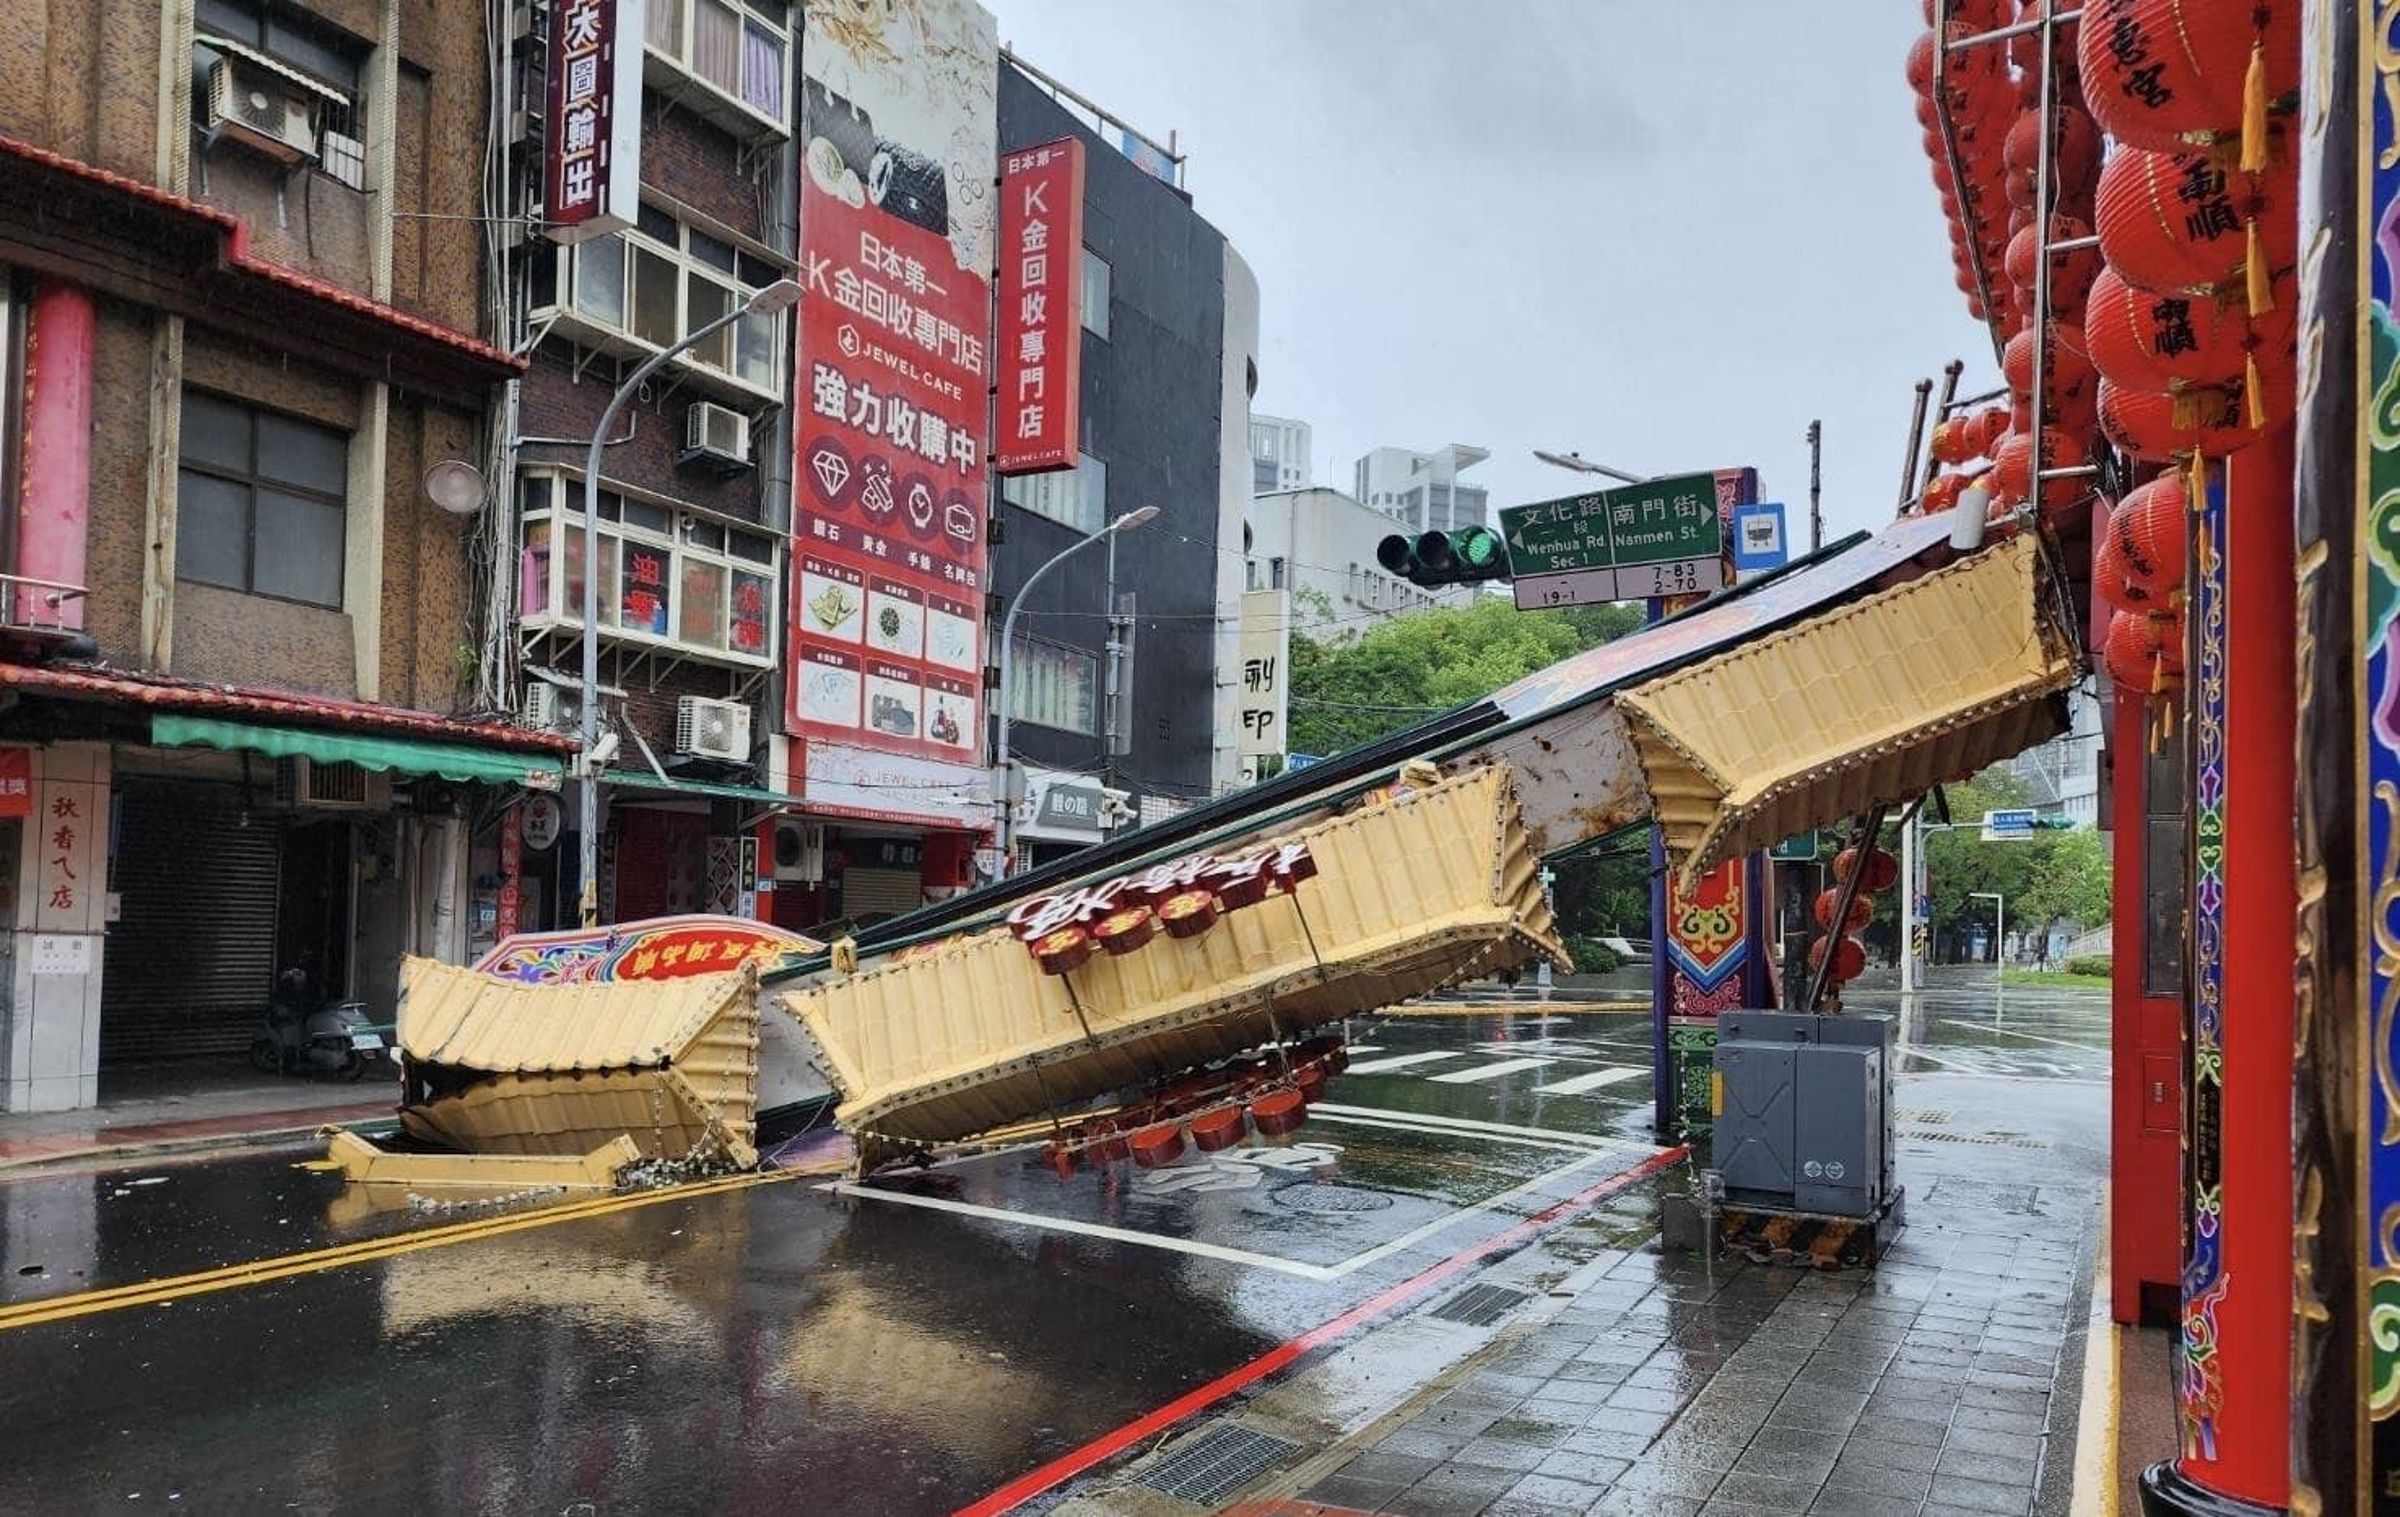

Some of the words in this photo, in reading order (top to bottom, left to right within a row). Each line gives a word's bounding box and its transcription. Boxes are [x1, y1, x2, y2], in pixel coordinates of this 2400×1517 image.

[566, 4, 600, 206] 大圖輸出
[1008, 150, 1065, 173] 日本第一
[860, 231, 948, 296] 日本第一
[808, 250, 984, 377] K金回收專門店
[1017, 181, 1048, 440] K金回收專門店
[863, 343, 919, 380] JEWEL
[923, 371, 963, 401] CAFE
[812, 363, 978, 476] 強力收購中
[1519, 496, 1601, 527] 文化路
[1613, 494, 1698, 526] 南門街
[1528, 537, 1581, 555] Wenhua
[1615, 530, 1674, 547] Nanmen
[1583, 553, 1589, 564] 1
[1653, 563, 1696, 580] 7-83
[1543, 590, 1576, 605] 19-1
[1654, 578, 1697, 595] 2-70
